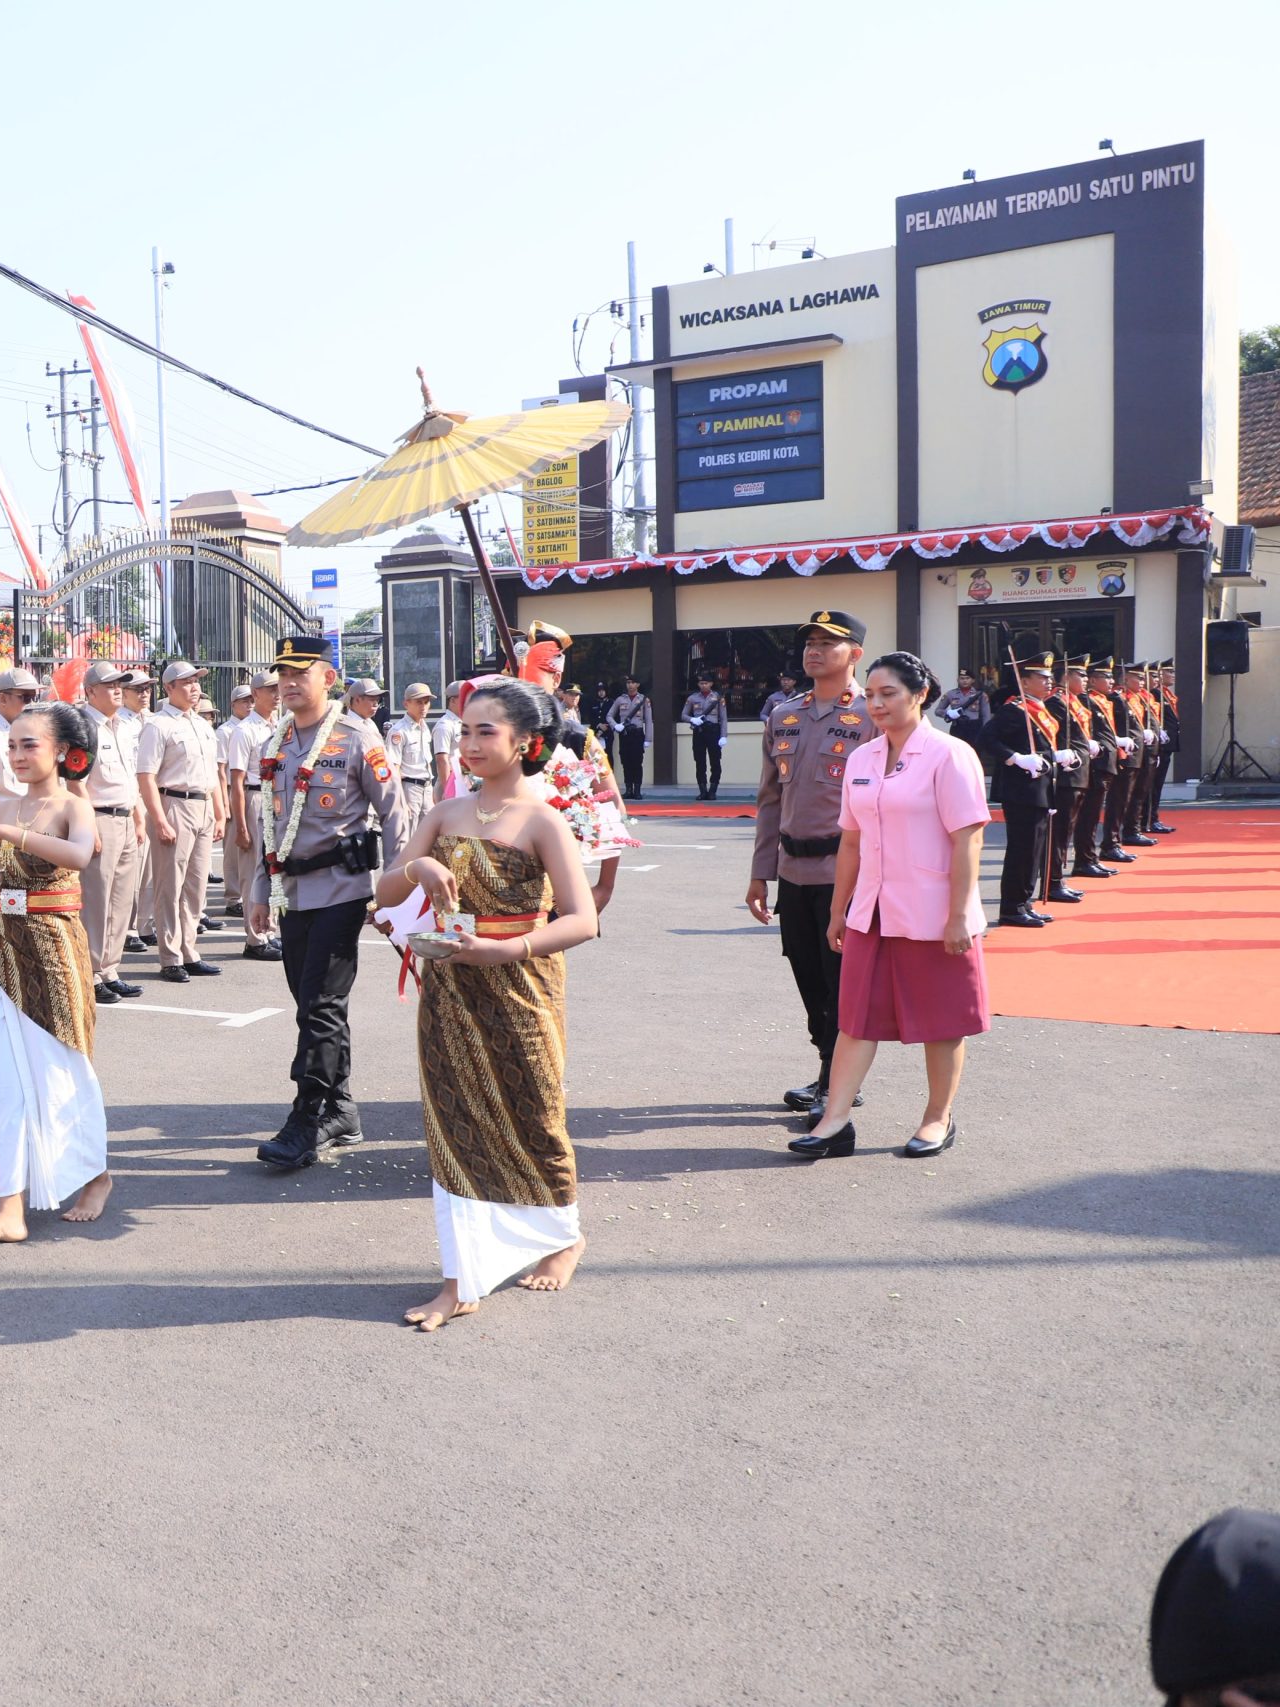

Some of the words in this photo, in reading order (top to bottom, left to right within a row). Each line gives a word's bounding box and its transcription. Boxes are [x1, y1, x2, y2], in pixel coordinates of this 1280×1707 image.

[906, 199, 997, 233] PELAYANAN
[1005, 183, 1081, 215] TERPADU
[1089, 173, 1134, 201] SATU
[1141, 162, 1195, 192] PINTU
[679, 299, 784, 328] WICAKSANA
[790, 284, 880, 312] LAGHAWA
[983, 305, 1011, 320] JAWA
[1013, 302, 1046, 312] TIMUR
[709, 379, 787, 402] PROPAM
[713, 413, 784, 433] PAMINAL
[698, 452, 735, 468] POLRES
[738, 449, 770, 464] KEDIRI
[773, 446, 799, 460] KOTA
[552, 462, 568, 472] SDM
[537, 476, 563, 487] BAGLOG
[537, 528, 576, 540] SATSAMAPTA
[537, 543, 568, 554] SATTAHTI
[537, 557, 559, 566] SIWAS
[1002, 589, 1029, 597] RUANG
[1030, 588, 1057, 596] DUMAS
[1058, 586, 1087, 594] PRESISI
[827, 727, 861, 741] POLRI
[313, 759, 346, 769] POLRI
